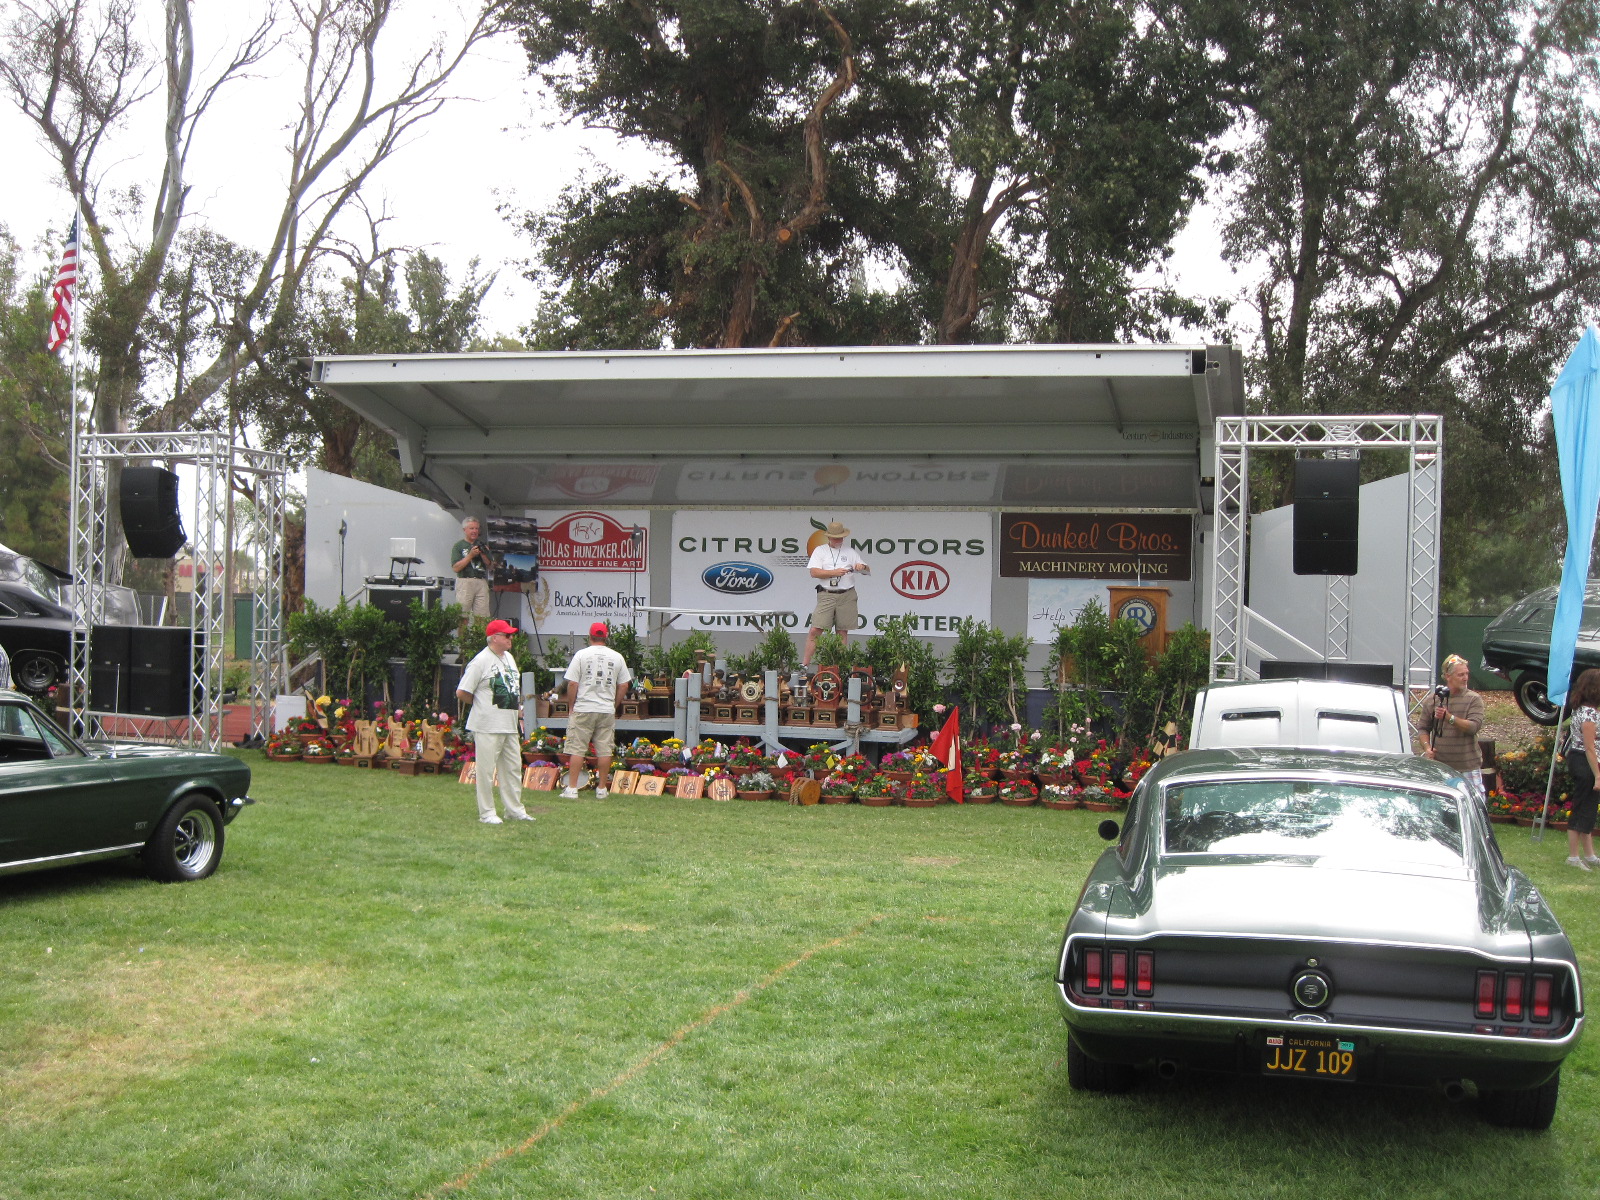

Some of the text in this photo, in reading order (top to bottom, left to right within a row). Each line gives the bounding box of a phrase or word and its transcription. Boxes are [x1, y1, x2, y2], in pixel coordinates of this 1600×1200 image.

[538, 535, 570, 558] ICOLAS
[678, 536, 985, 556] CITRUS MOTORS
[1009, 521, 1181, 551] Dunkel Bros.
[538, 559, 594, 567] UTOMOTIVE
[622, 560, 642, 568] ART
[1019, 561, 1169, 575] MACHINERY MOVING
[715, 566, 759, 589] Ford
[901, 569, 940, 591] KIA
[1033, 607, 1066, 624] Help
[1288, 1038, 1331, 1048] CALIFORNIA
[1266, 1047, 1353, 1075] JJZ 109
